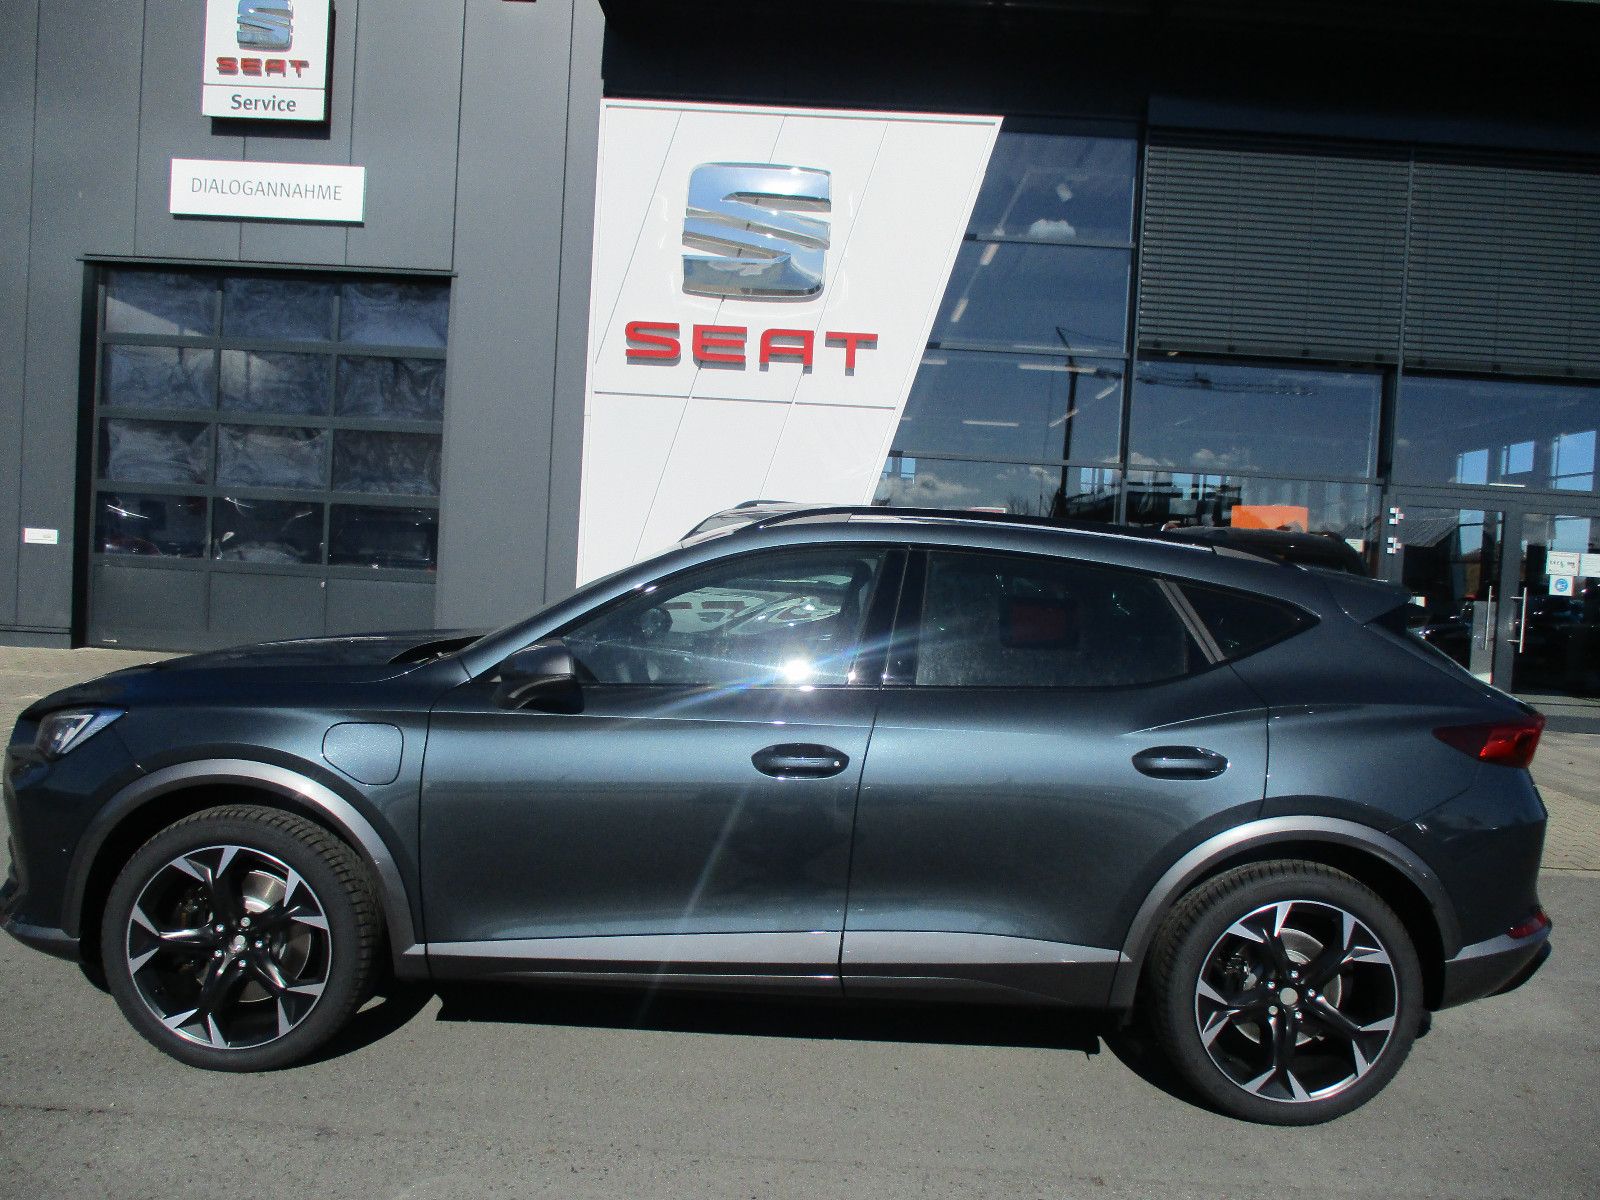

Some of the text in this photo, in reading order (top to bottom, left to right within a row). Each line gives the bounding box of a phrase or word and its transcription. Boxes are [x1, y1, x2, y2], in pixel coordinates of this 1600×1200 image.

[216, 56, 309, 77] SEAT
[231, 94, 297, 113] Service
[191, 177, 343, 201] DIALOGANNAHME
[624, 320, 879, 369] SEAT
